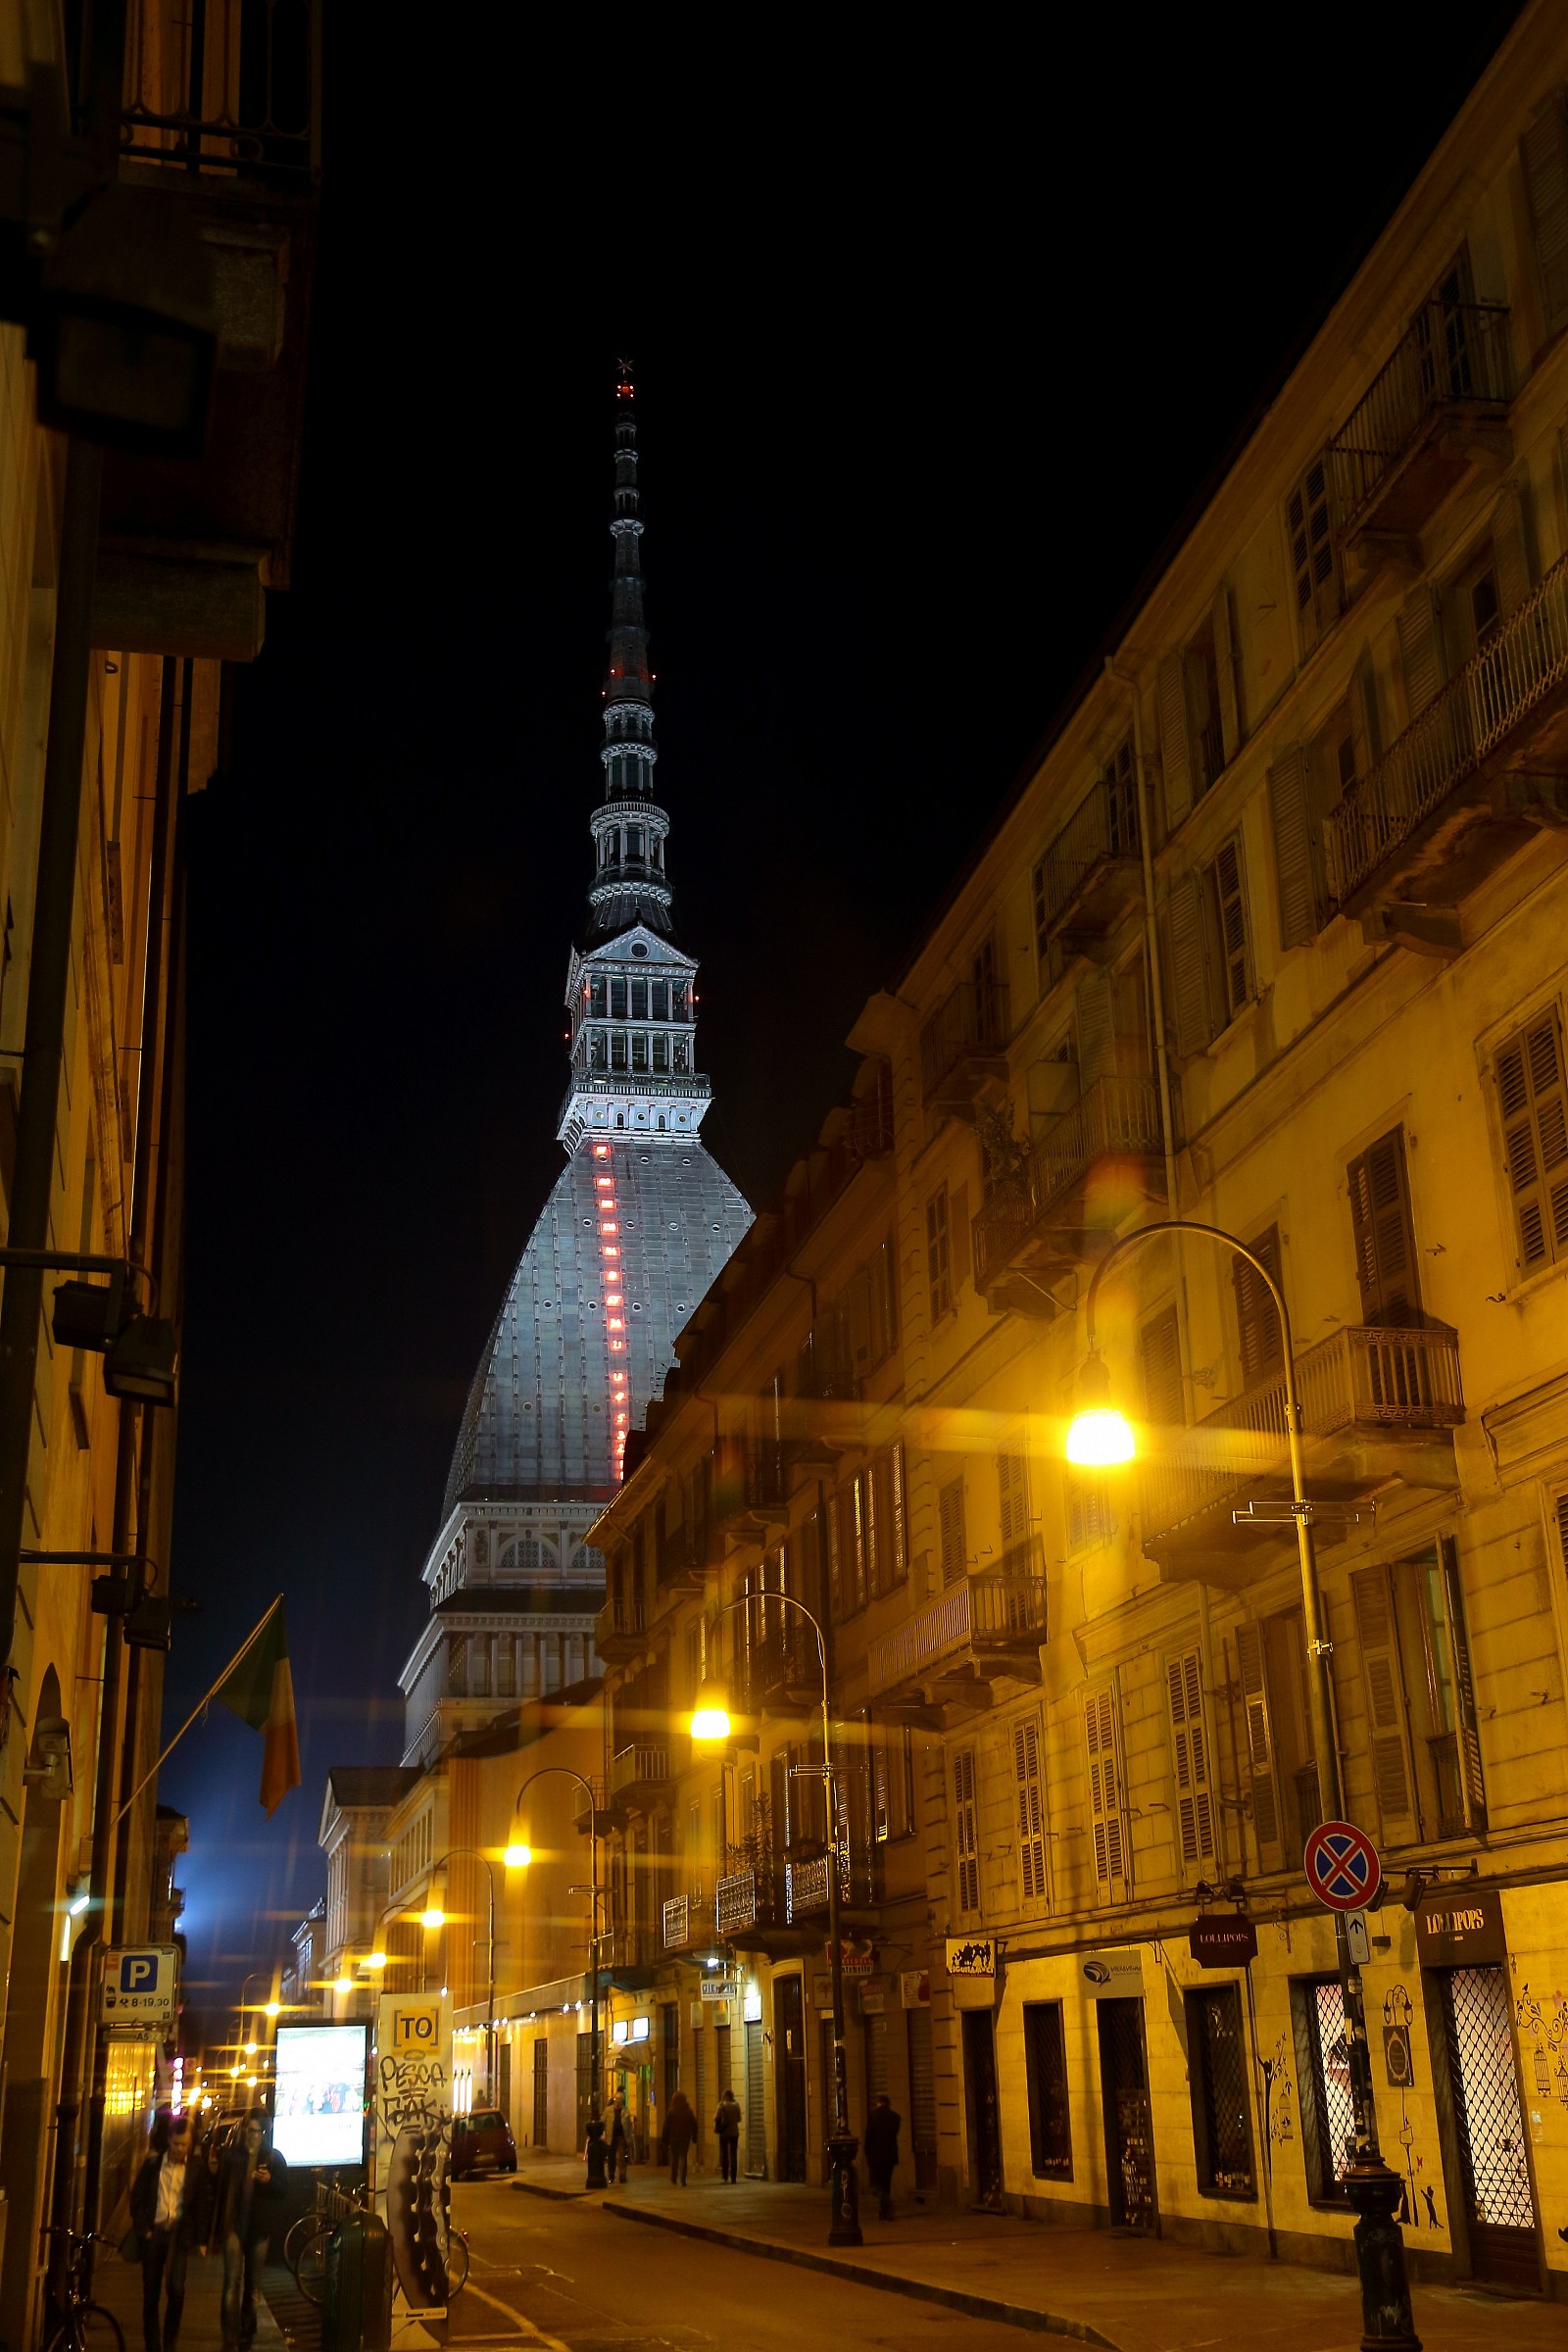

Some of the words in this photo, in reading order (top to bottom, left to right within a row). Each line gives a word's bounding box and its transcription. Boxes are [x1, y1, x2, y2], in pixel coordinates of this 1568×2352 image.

[1425, 1908, 1485, 1935] LOLLIPOPS
[1200, 1933, 1249, 1943] LOLLIPOPS
[129, 1960, 151, 1988] P
